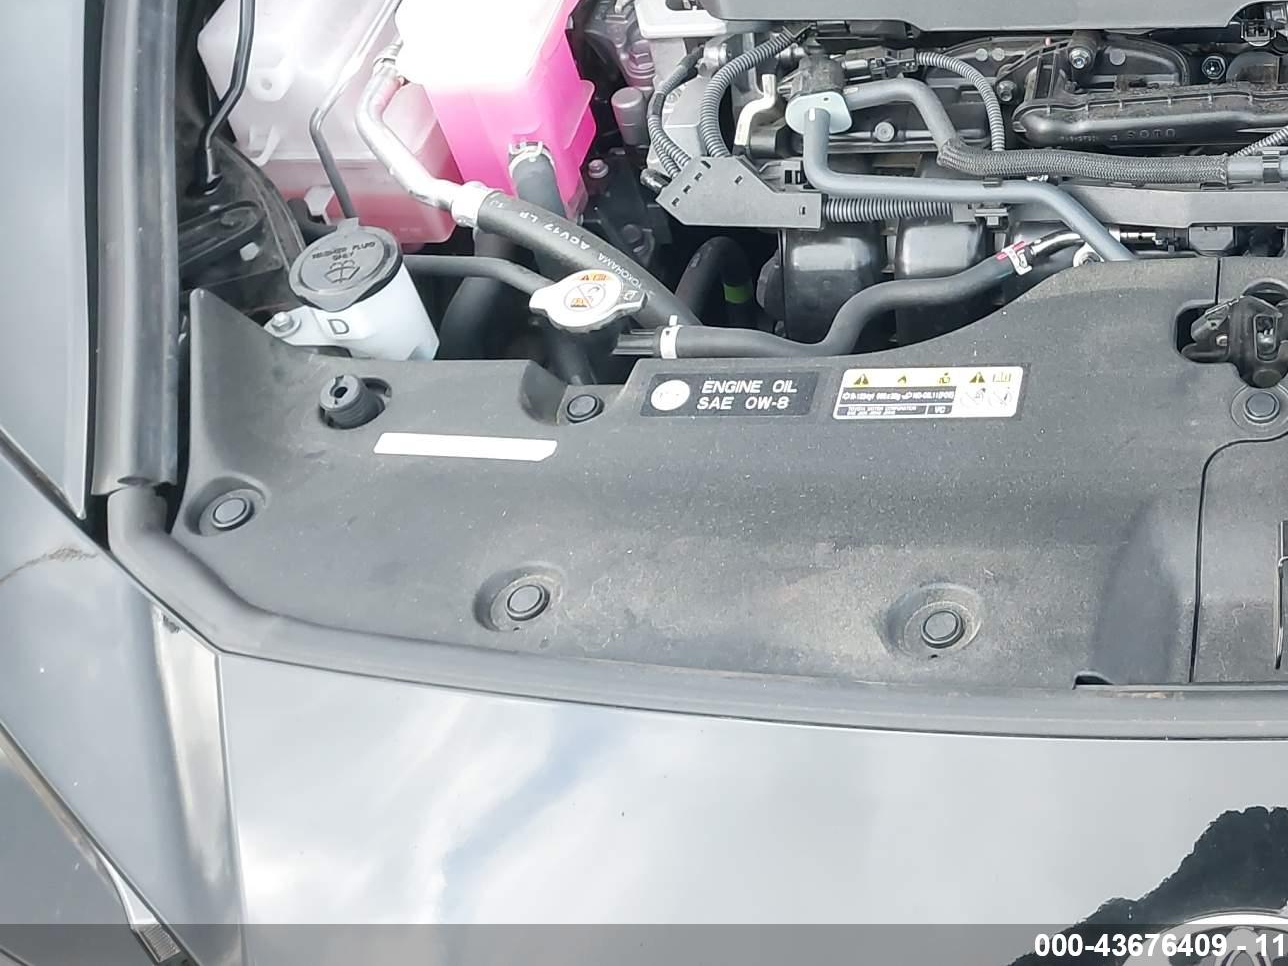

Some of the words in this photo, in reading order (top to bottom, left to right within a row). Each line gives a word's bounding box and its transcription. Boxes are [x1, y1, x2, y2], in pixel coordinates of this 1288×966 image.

[598, 252, 642, 290] YOKOHAMA
[328, 318, 350, 335] D
[701, 380, 763, 394] ENGINE
[772, 380, 797, 393] OIL
[696, 396, 734, 410] SAE
[745, 396, 790, 410] 0W-8
